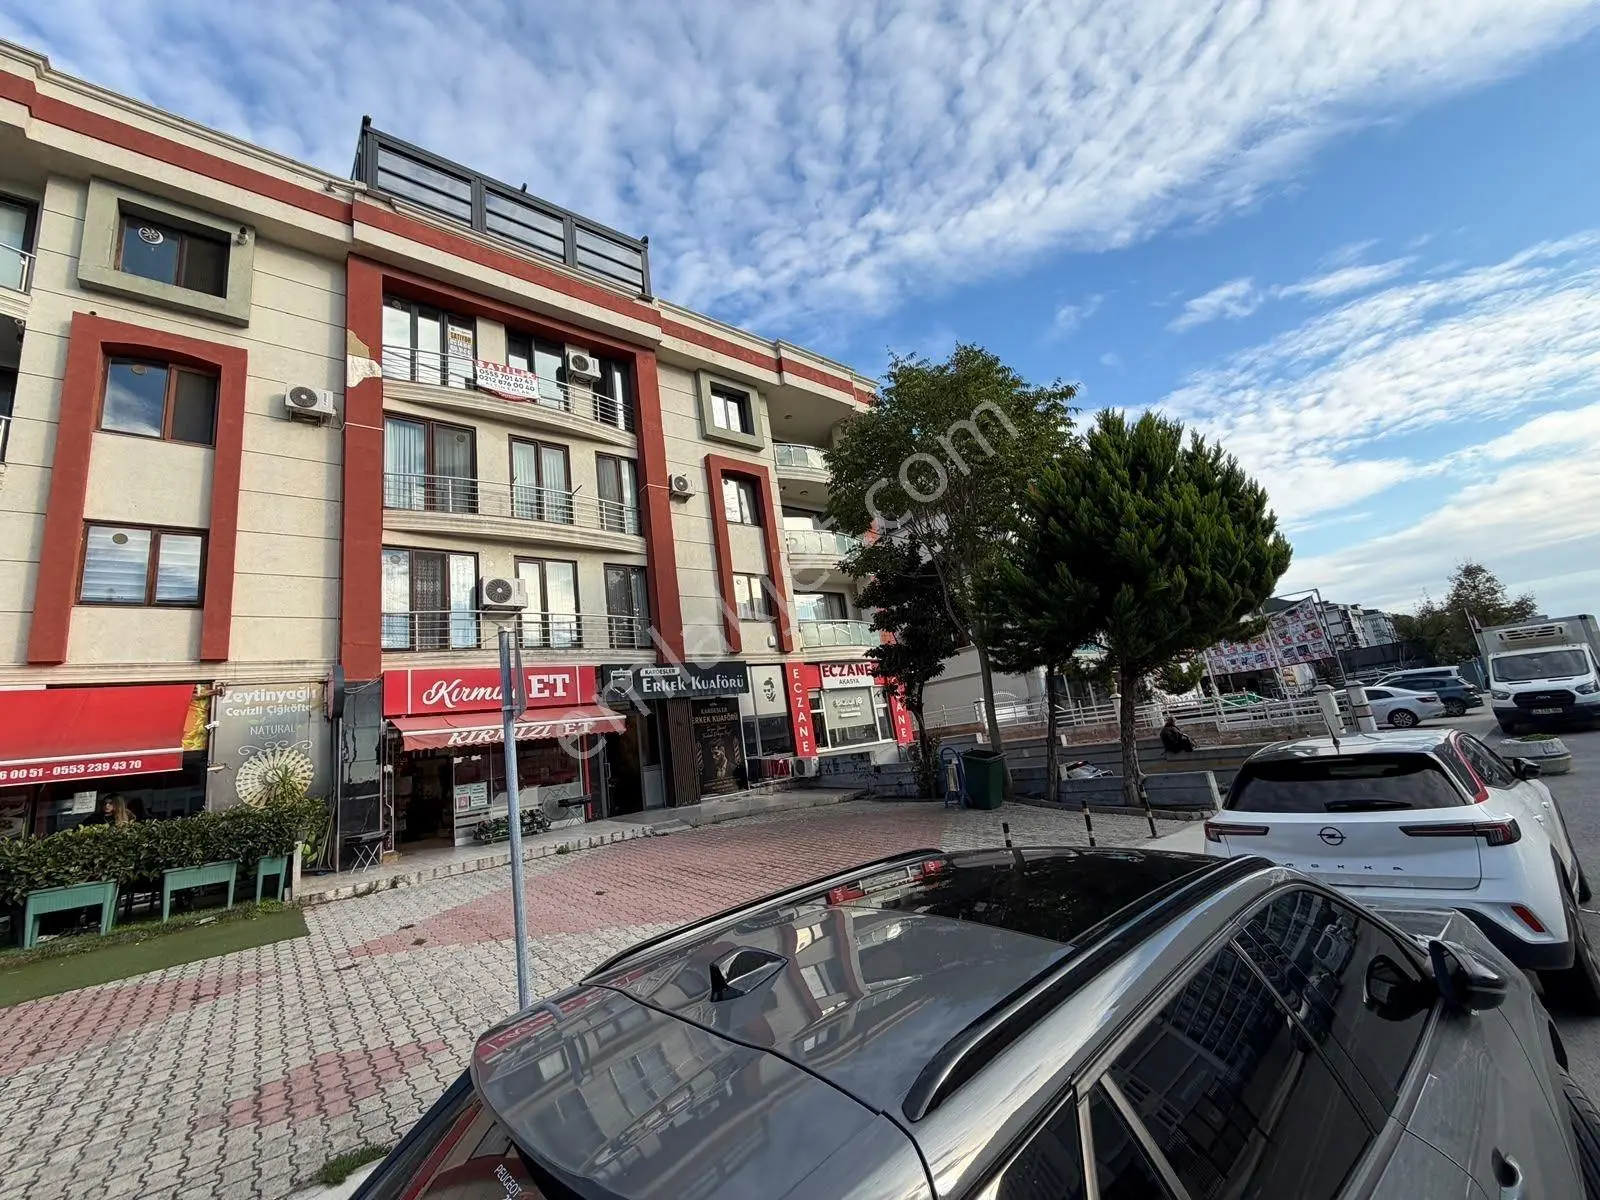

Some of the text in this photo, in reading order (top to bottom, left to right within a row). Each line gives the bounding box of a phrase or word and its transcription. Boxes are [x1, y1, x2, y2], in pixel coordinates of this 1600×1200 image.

[479, 374, 497, 383] 0212
[500, 374, 513, 382] 701
[821, 663, 872, 678] ECZANE
[527, 673, 570, 698] ET
[222, 686, 317, 705] Zeytinyağlı
[793, 668, 810, 752] ECZANE
[250, 724, 296, 735] NATURAL
[563, 722, 593, 735] ET
[10, 769, 27, 779] 00
[29, 767, 43, 778] 51
[52, 764, 85, 775] 0553
[87, 763, 110, 773] 239
[112, 761, 126, 771] 43
[129, 760, 142, 769] 70
[493, 1163, 522, 1198] PEUGEOT
